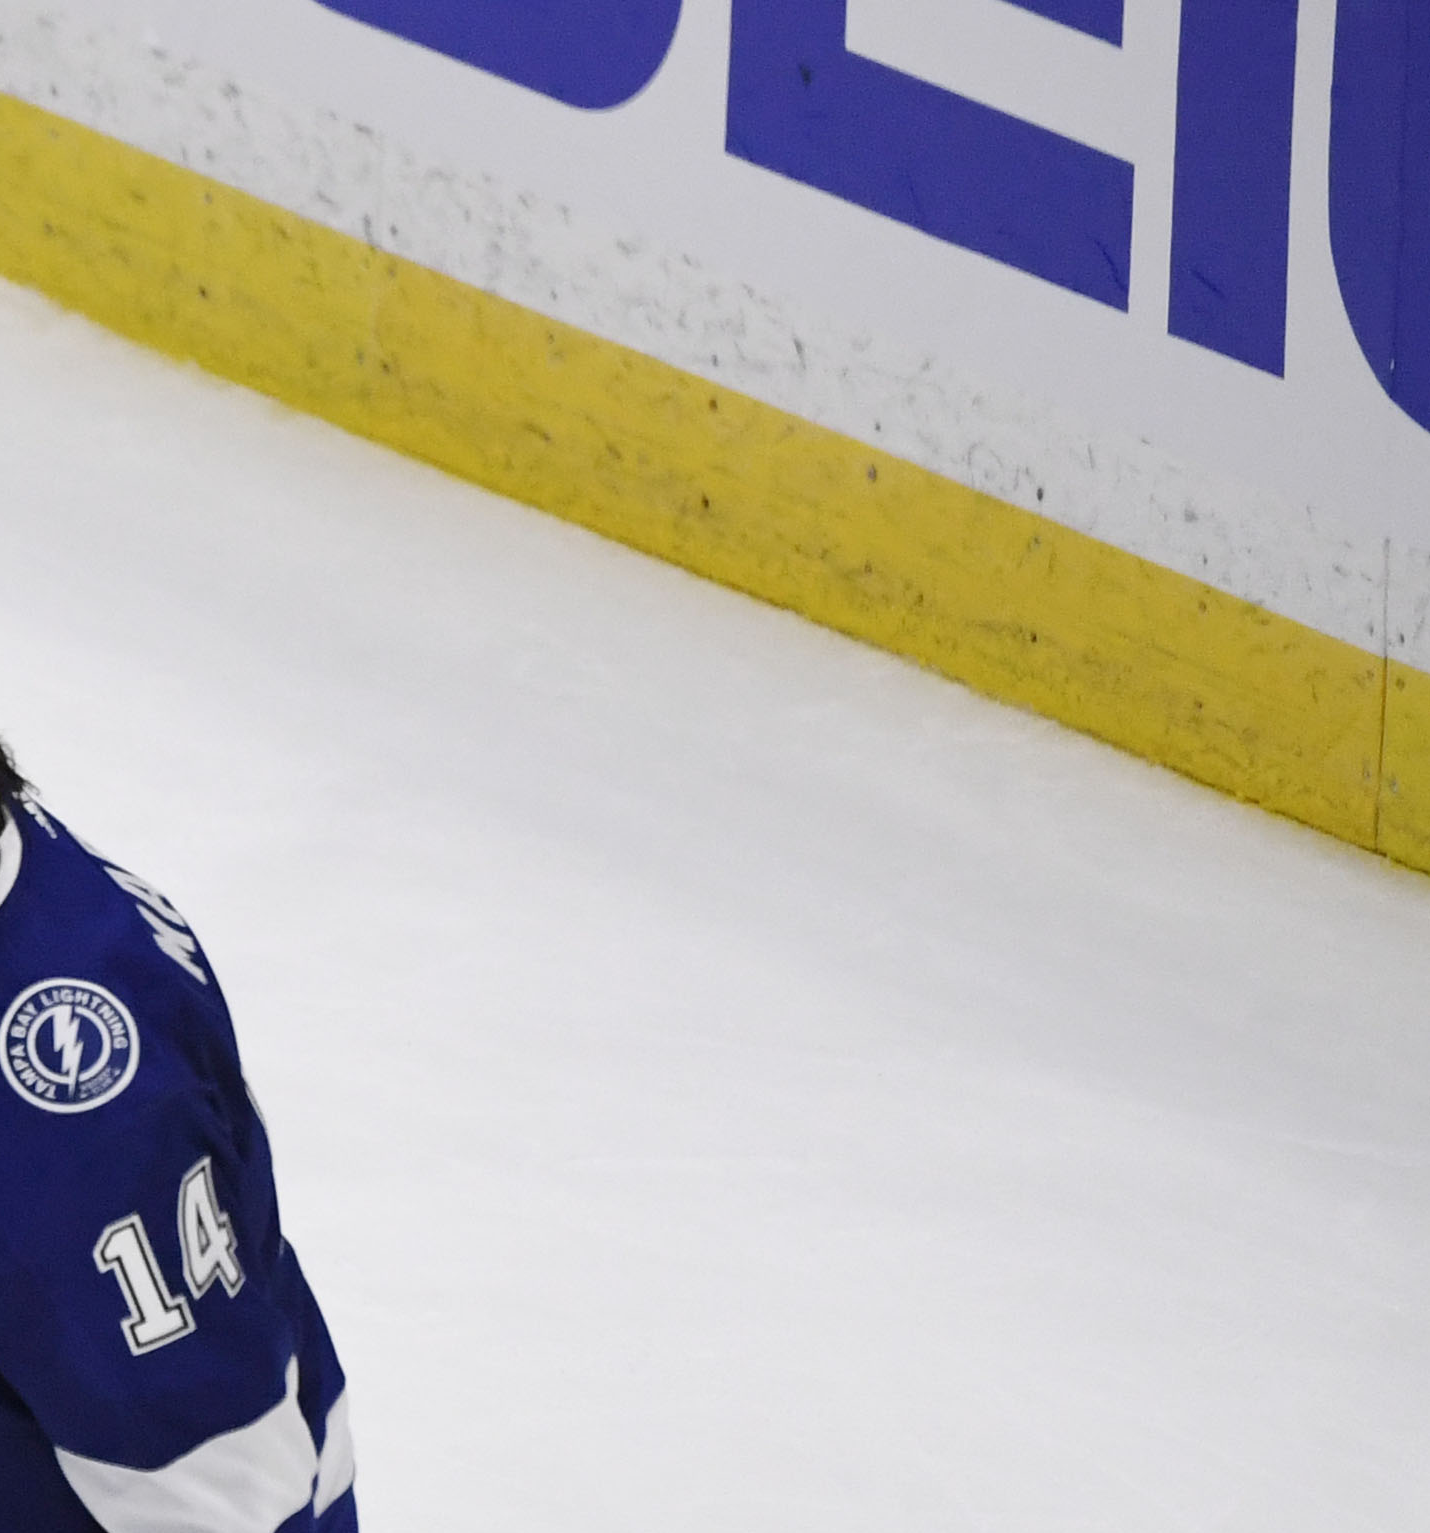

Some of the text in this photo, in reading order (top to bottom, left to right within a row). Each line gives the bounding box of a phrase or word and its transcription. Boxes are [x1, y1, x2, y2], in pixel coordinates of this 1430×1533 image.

[9, 1001, 39, 1039] BAY
[40, 988, 129, 1049] LIGHTNING
[9, 1044, 57, 1099] TAMPA
[93, 1155, 245, 1356] 14
